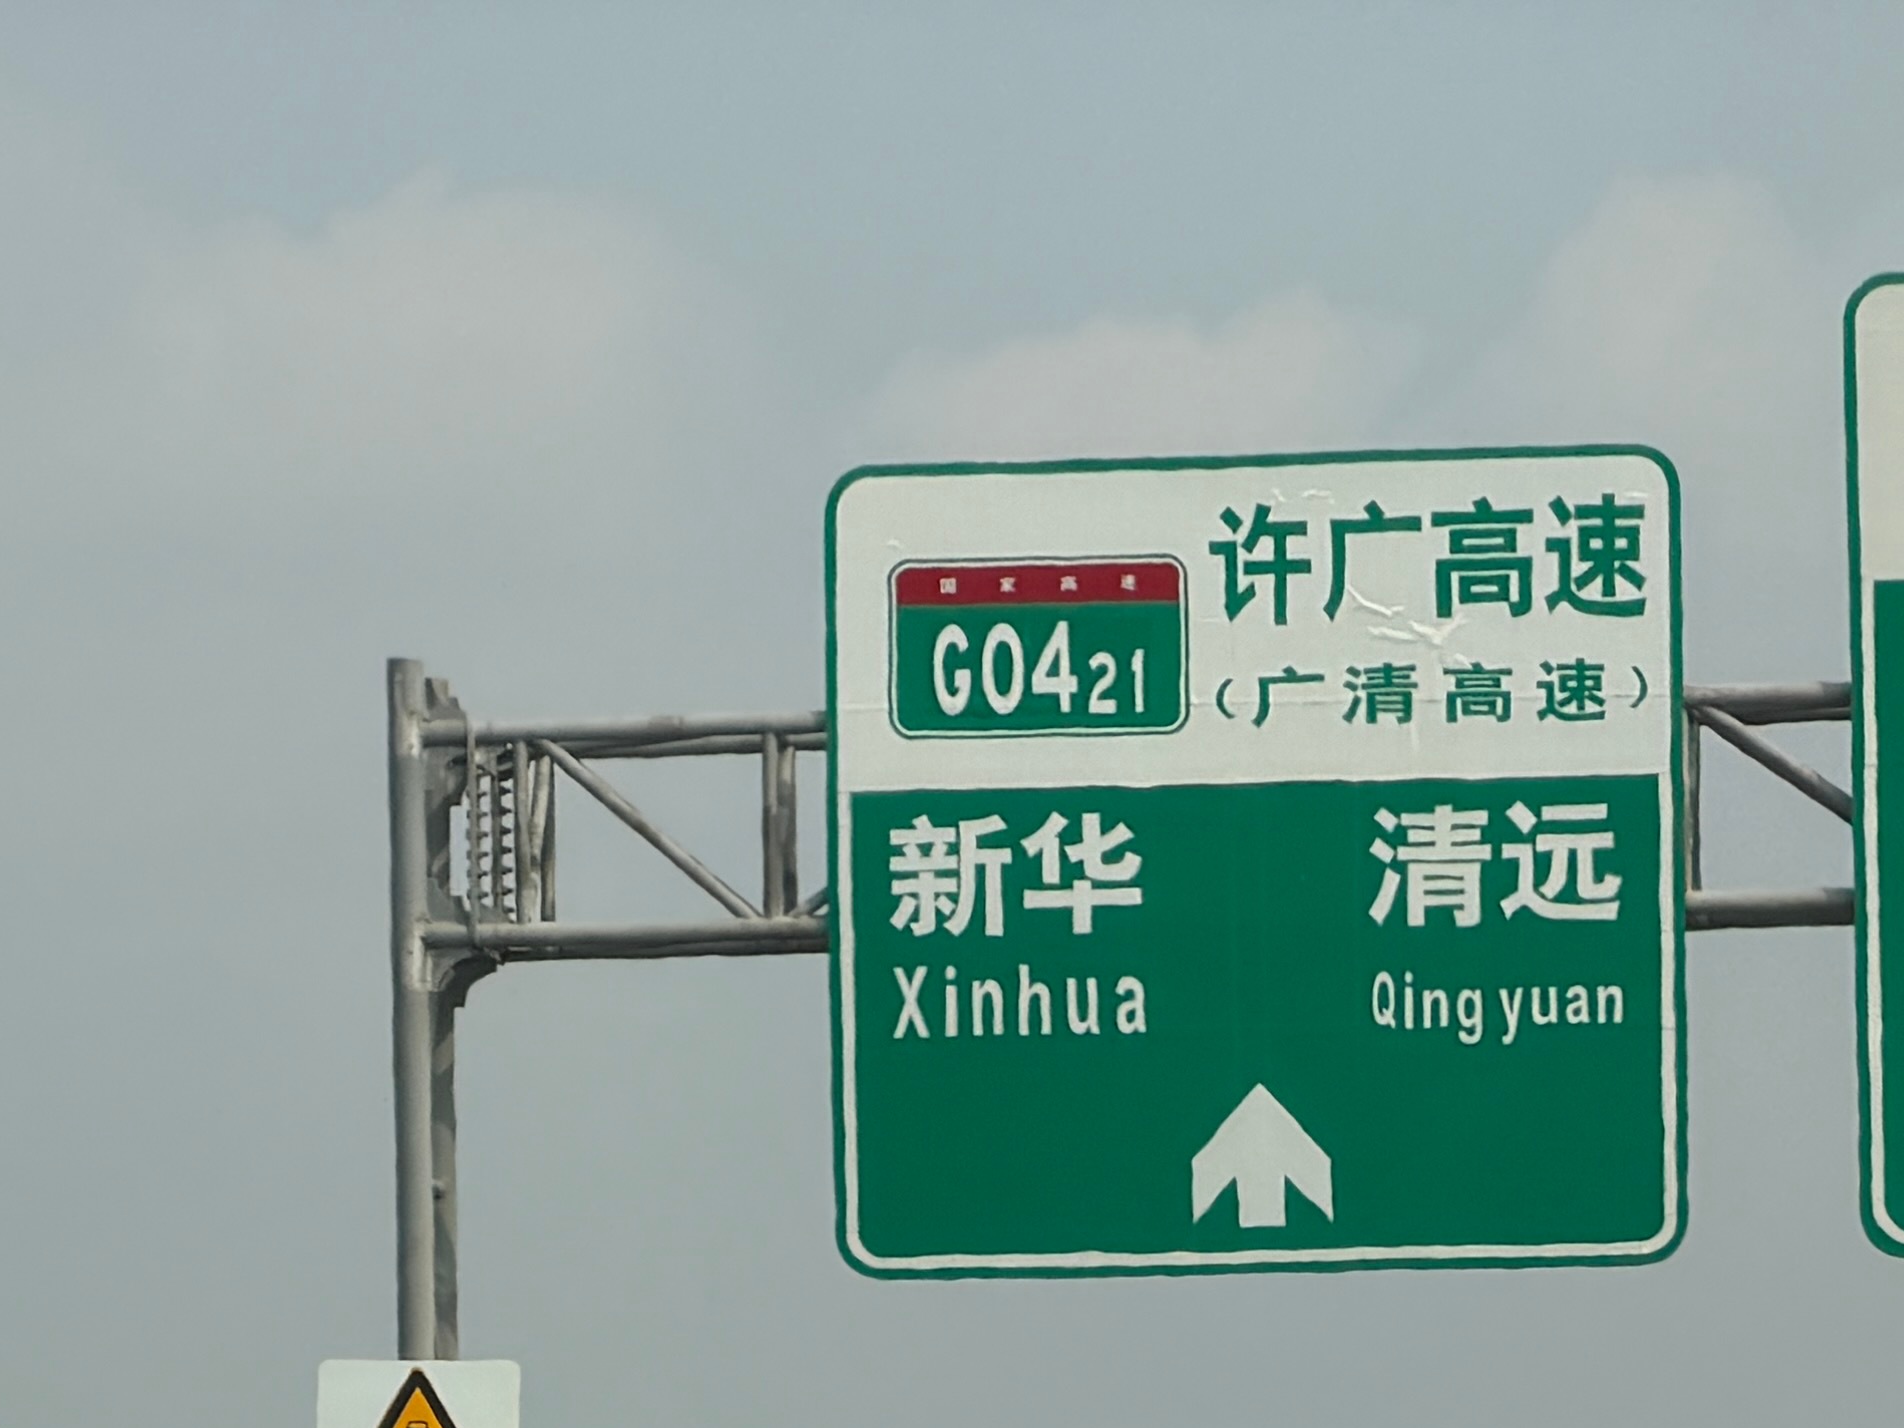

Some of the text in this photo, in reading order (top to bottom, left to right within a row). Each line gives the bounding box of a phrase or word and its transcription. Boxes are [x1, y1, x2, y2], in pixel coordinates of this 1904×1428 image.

[1208, 494, 1649, 626] 许广高速
[933, 620, 1146, 716] G0421
[1214, 658, 1650, 728] （广清高速）
[888, 801, 1623, 938] 新华 清远
[892, 964, 1625, 1044] Xinhua Qingyuan
